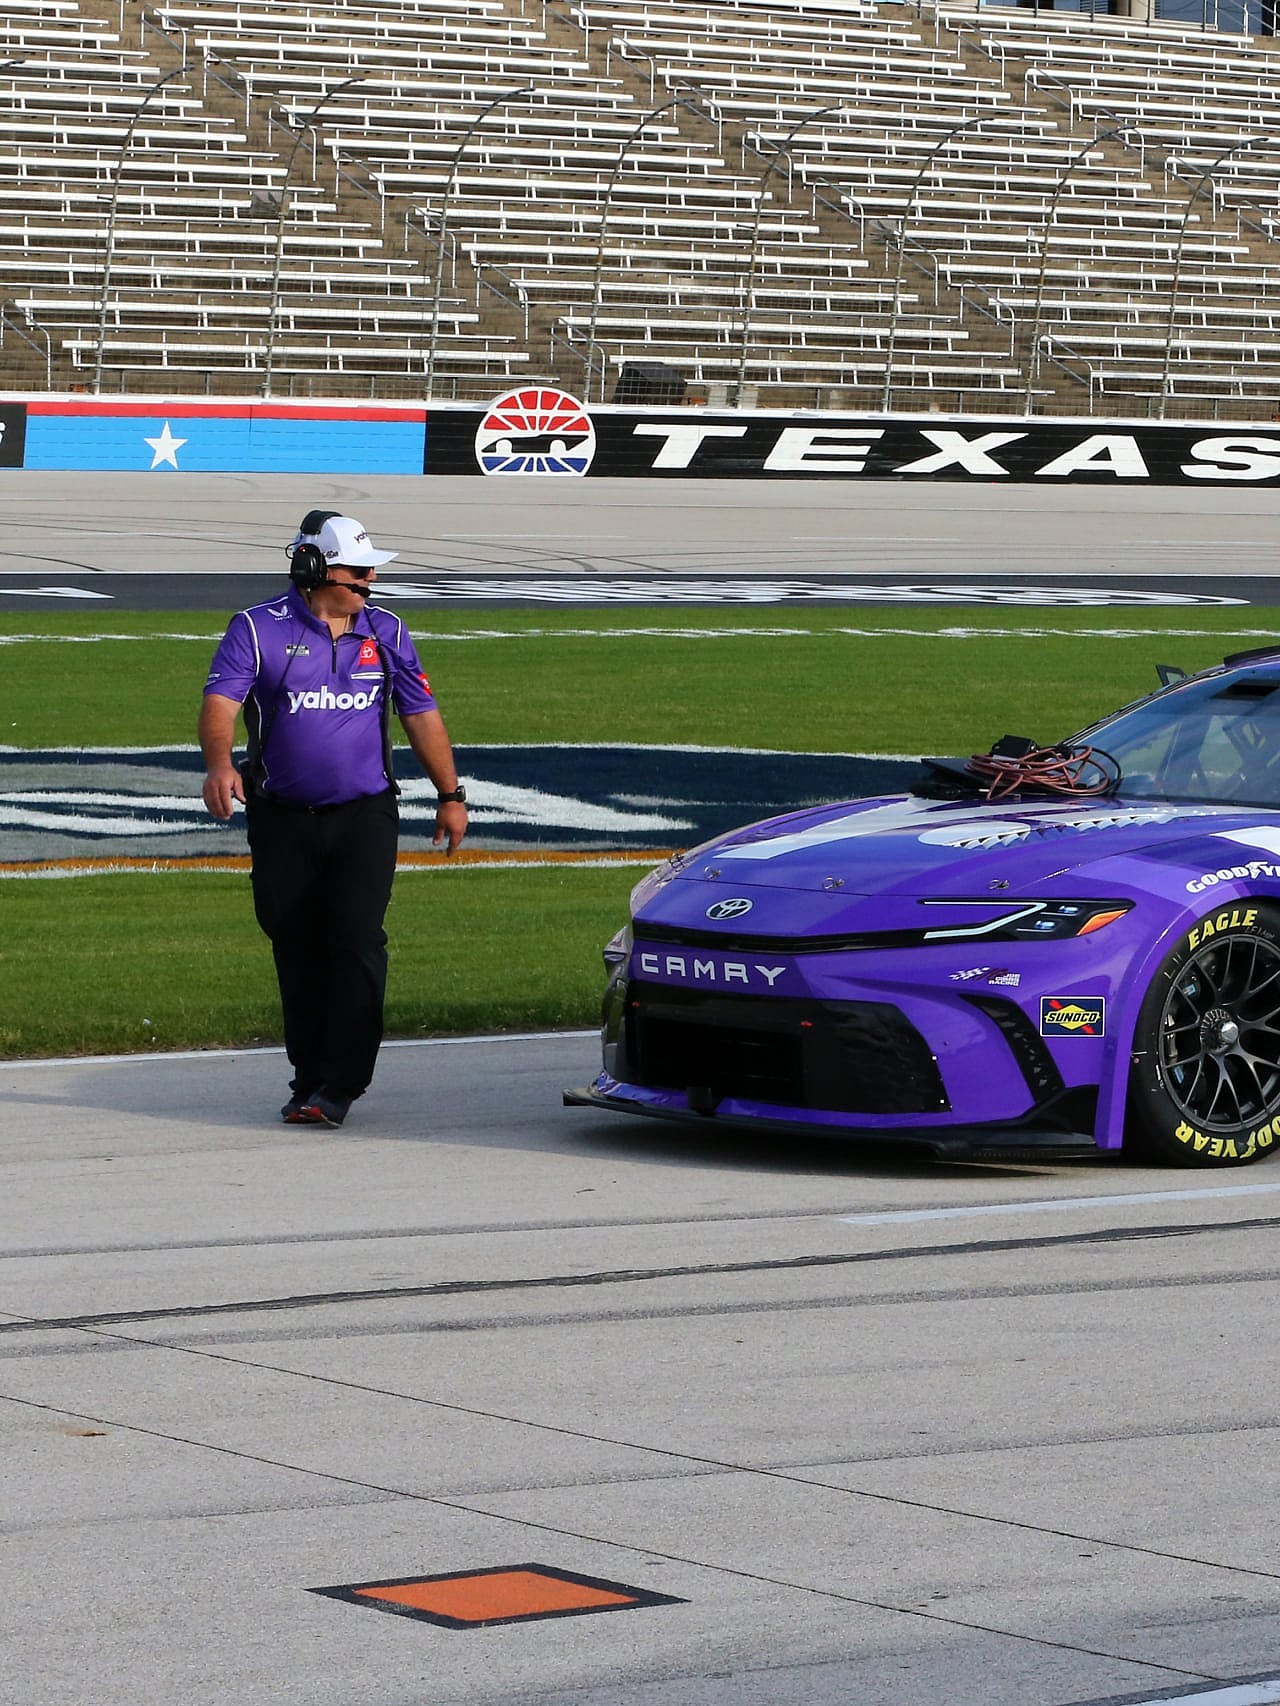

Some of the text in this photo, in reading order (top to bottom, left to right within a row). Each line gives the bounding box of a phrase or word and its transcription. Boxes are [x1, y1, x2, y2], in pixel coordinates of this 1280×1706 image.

[287, 686, 379, 713] yahoo!
[1187, 909, 1258, 952] EAGLE
[640, 953, 786, 986] CAMRY
[1049, 1012, 1099, 1023] SUNOCO
